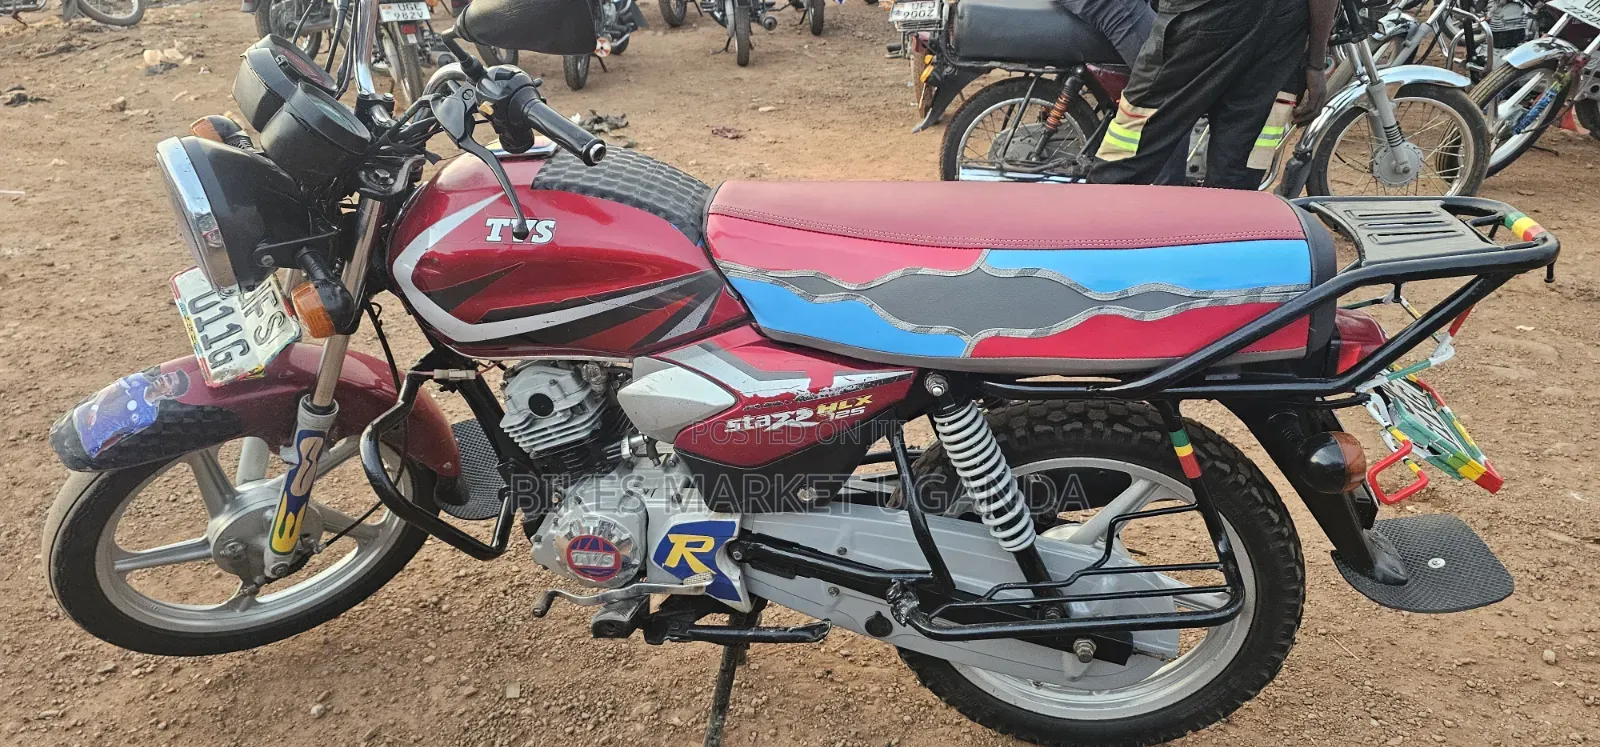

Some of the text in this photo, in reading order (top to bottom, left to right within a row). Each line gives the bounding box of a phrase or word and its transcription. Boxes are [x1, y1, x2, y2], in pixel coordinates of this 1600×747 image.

[816, 394, 873, 415] HLX
[571, 550, 615, 567] TVS
[662, 533, 717, 575] R
